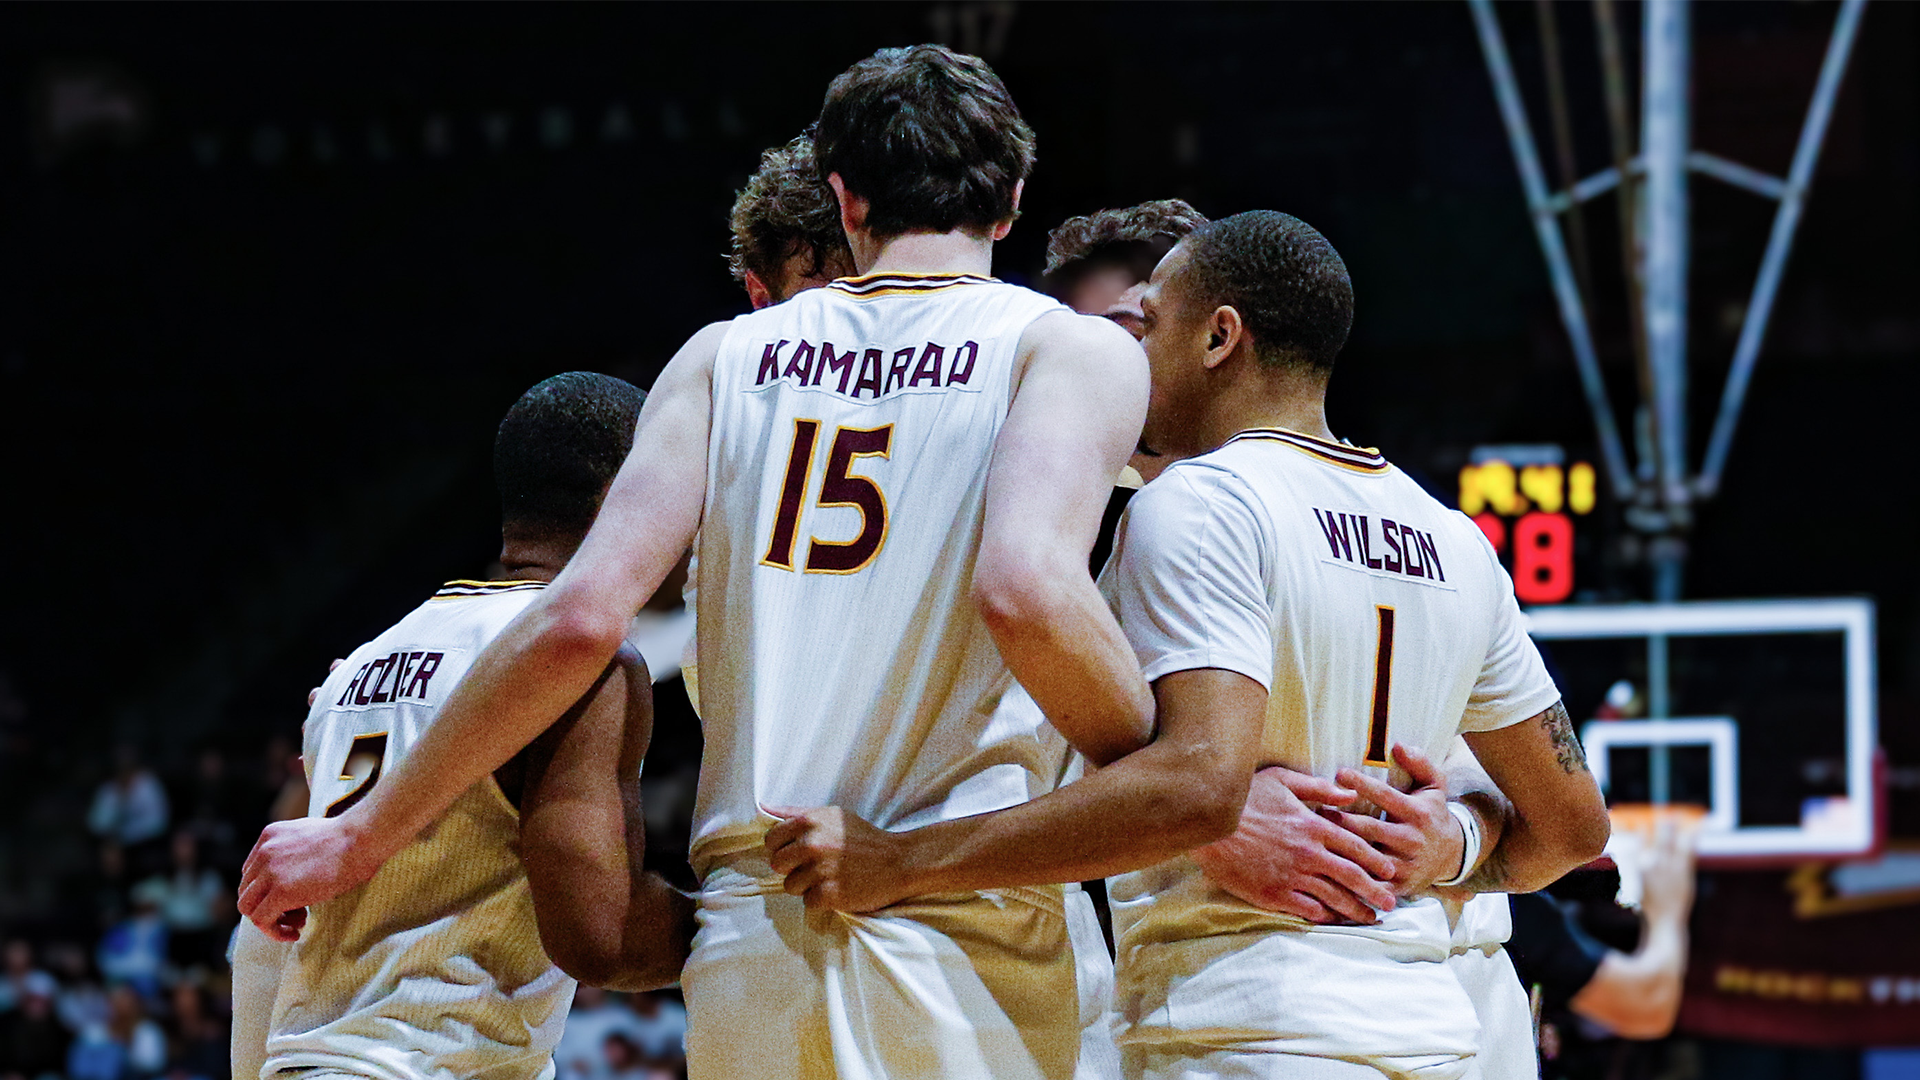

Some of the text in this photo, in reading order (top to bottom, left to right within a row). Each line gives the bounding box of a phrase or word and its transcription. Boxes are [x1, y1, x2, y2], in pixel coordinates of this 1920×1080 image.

[755, 338, 979, 399] KAMARAD
[759, 417, 895, 576] 15
[1312, 507, 1446, 583] WILSON
[336, 651, 445, 707] ROZIER
[1362, 603, 1396, 769] 1
